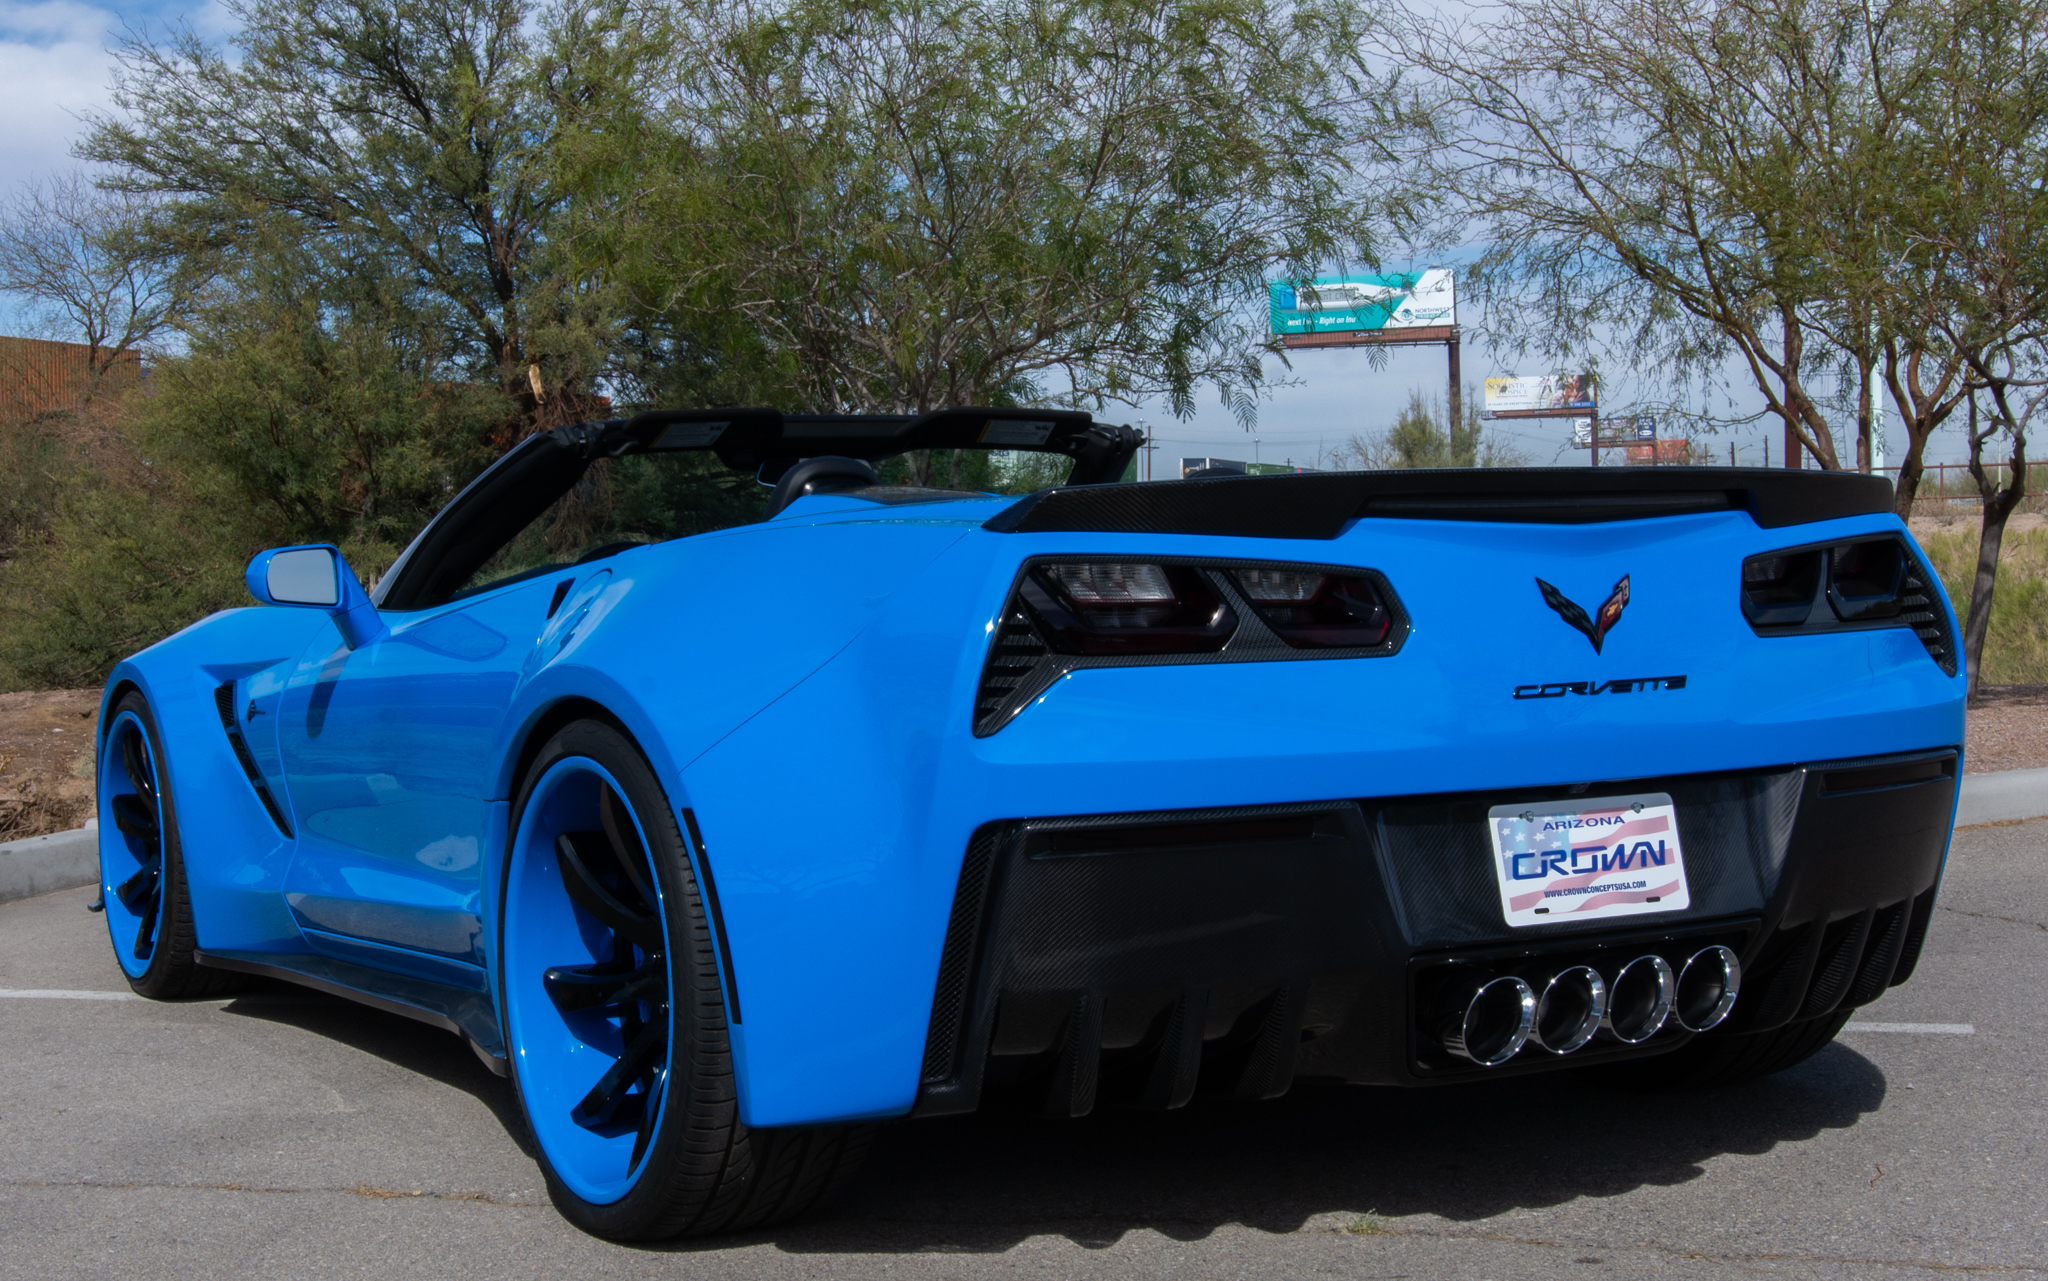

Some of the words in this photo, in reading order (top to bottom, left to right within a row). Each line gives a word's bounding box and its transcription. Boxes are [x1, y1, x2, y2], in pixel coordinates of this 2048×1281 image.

[1319, 316, 1335, 326] Right
[1512, 675, 1687, 700] CORVETTE
[1543, 815, 1626, 831] ARIZONA
[1512, 840, 1666, 880] CROWN
[1544, 880, 1647, 898] WWW.CROWNCONCEPTSUSA.COM
